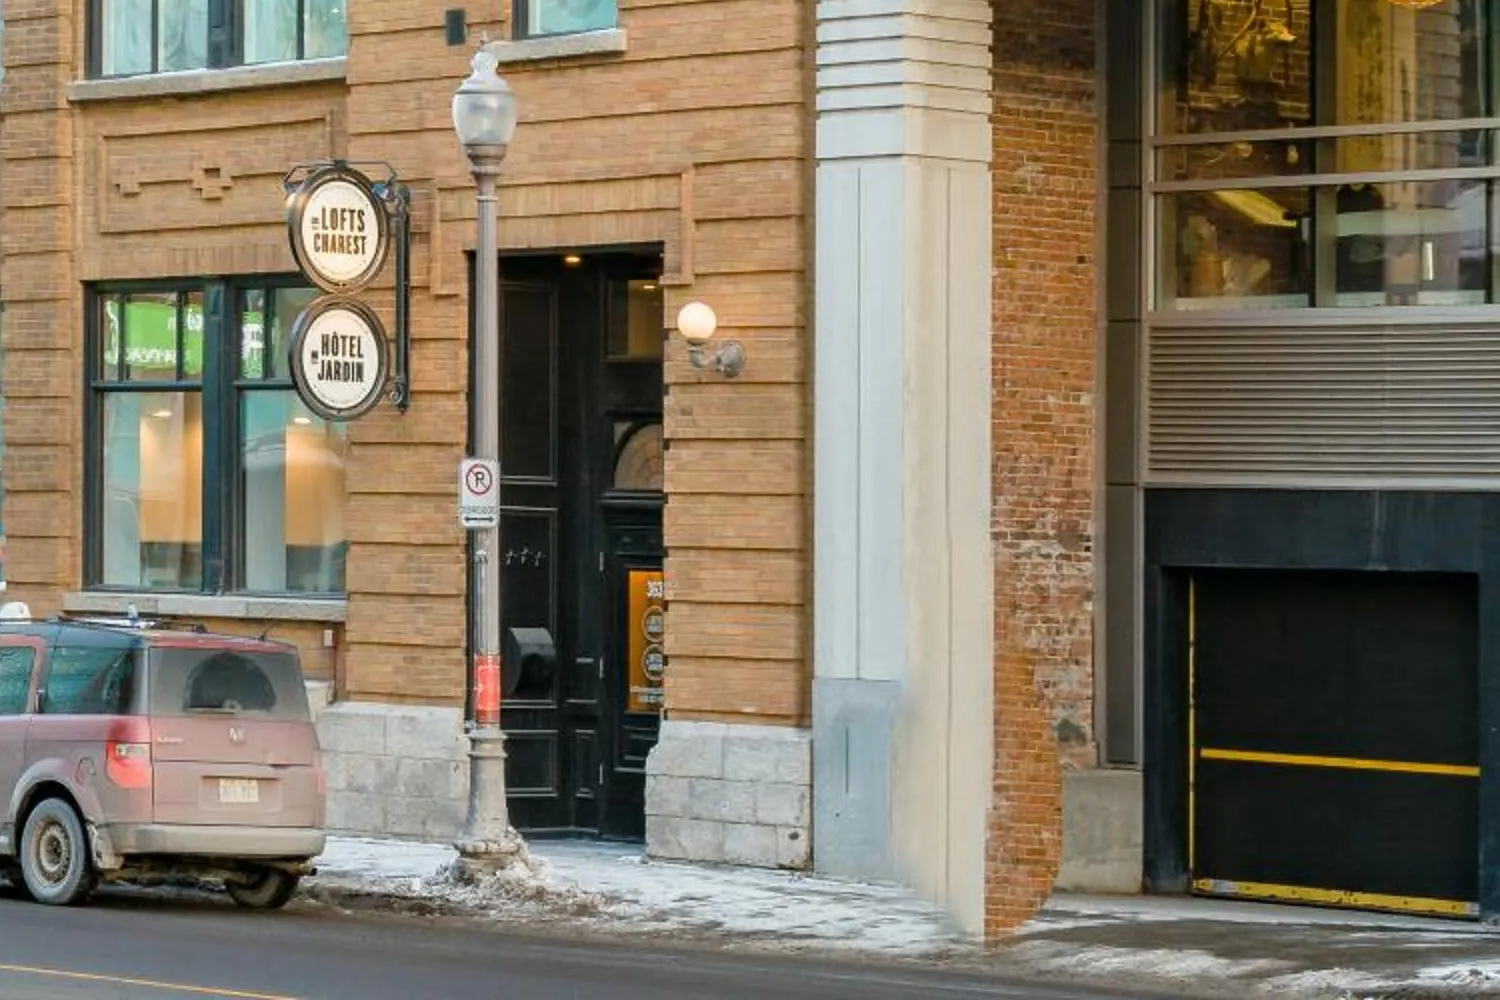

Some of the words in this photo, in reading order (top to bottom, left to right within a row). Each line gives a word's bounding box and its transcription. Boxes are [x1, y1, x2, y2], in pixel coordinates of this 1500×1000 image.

[321, 206, 365, 232] LOFTS
[314, 233, 366, 255] CHAREST
[321, 331, 364, 358] HÔTEL
[317, 360, 364, 382] JARDIN
